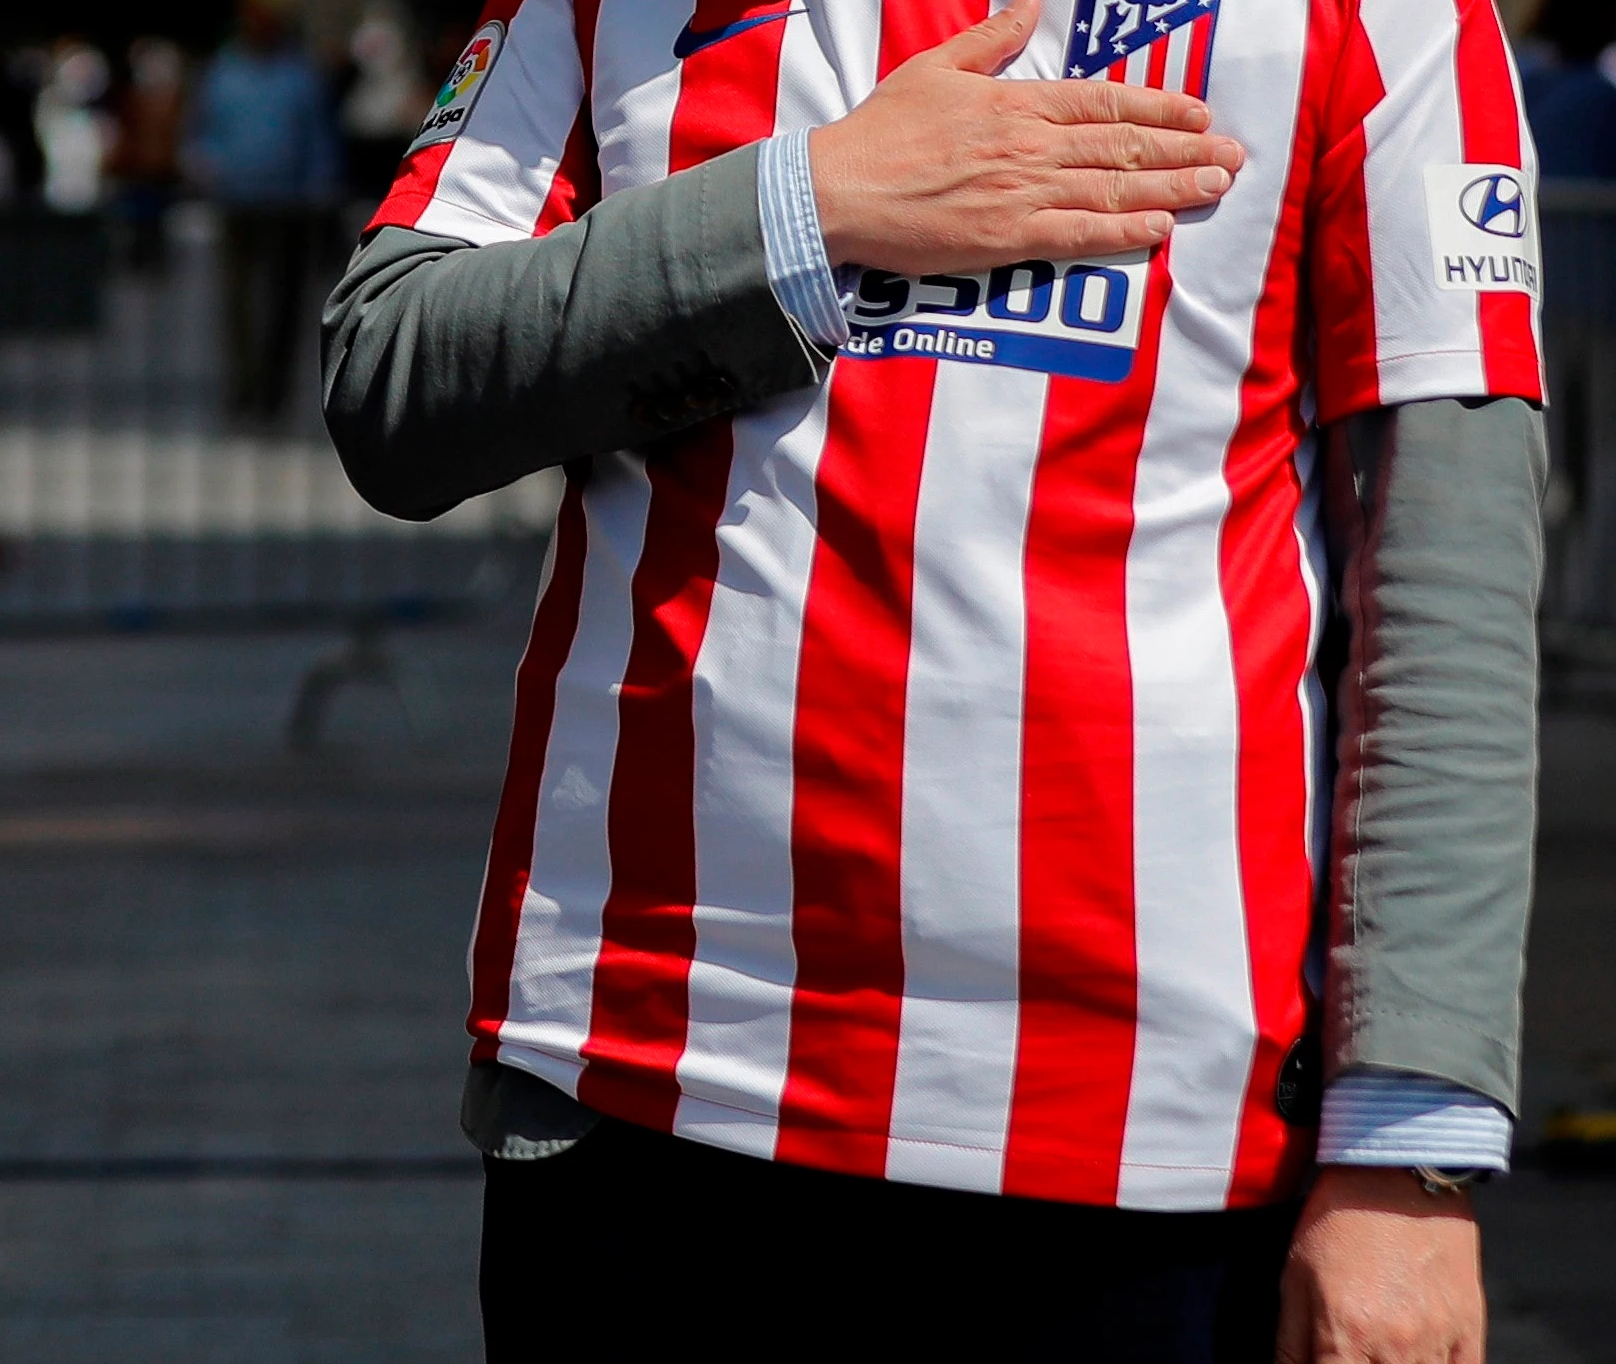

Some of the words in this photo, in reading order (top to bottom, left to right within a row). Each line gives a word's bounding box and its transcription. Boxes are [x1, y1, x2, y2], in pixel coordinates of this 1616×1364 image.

[840, 259, 1129, 334] s500
[839, 331, 885, 354] de
[892, 328, 995, 360] Online
